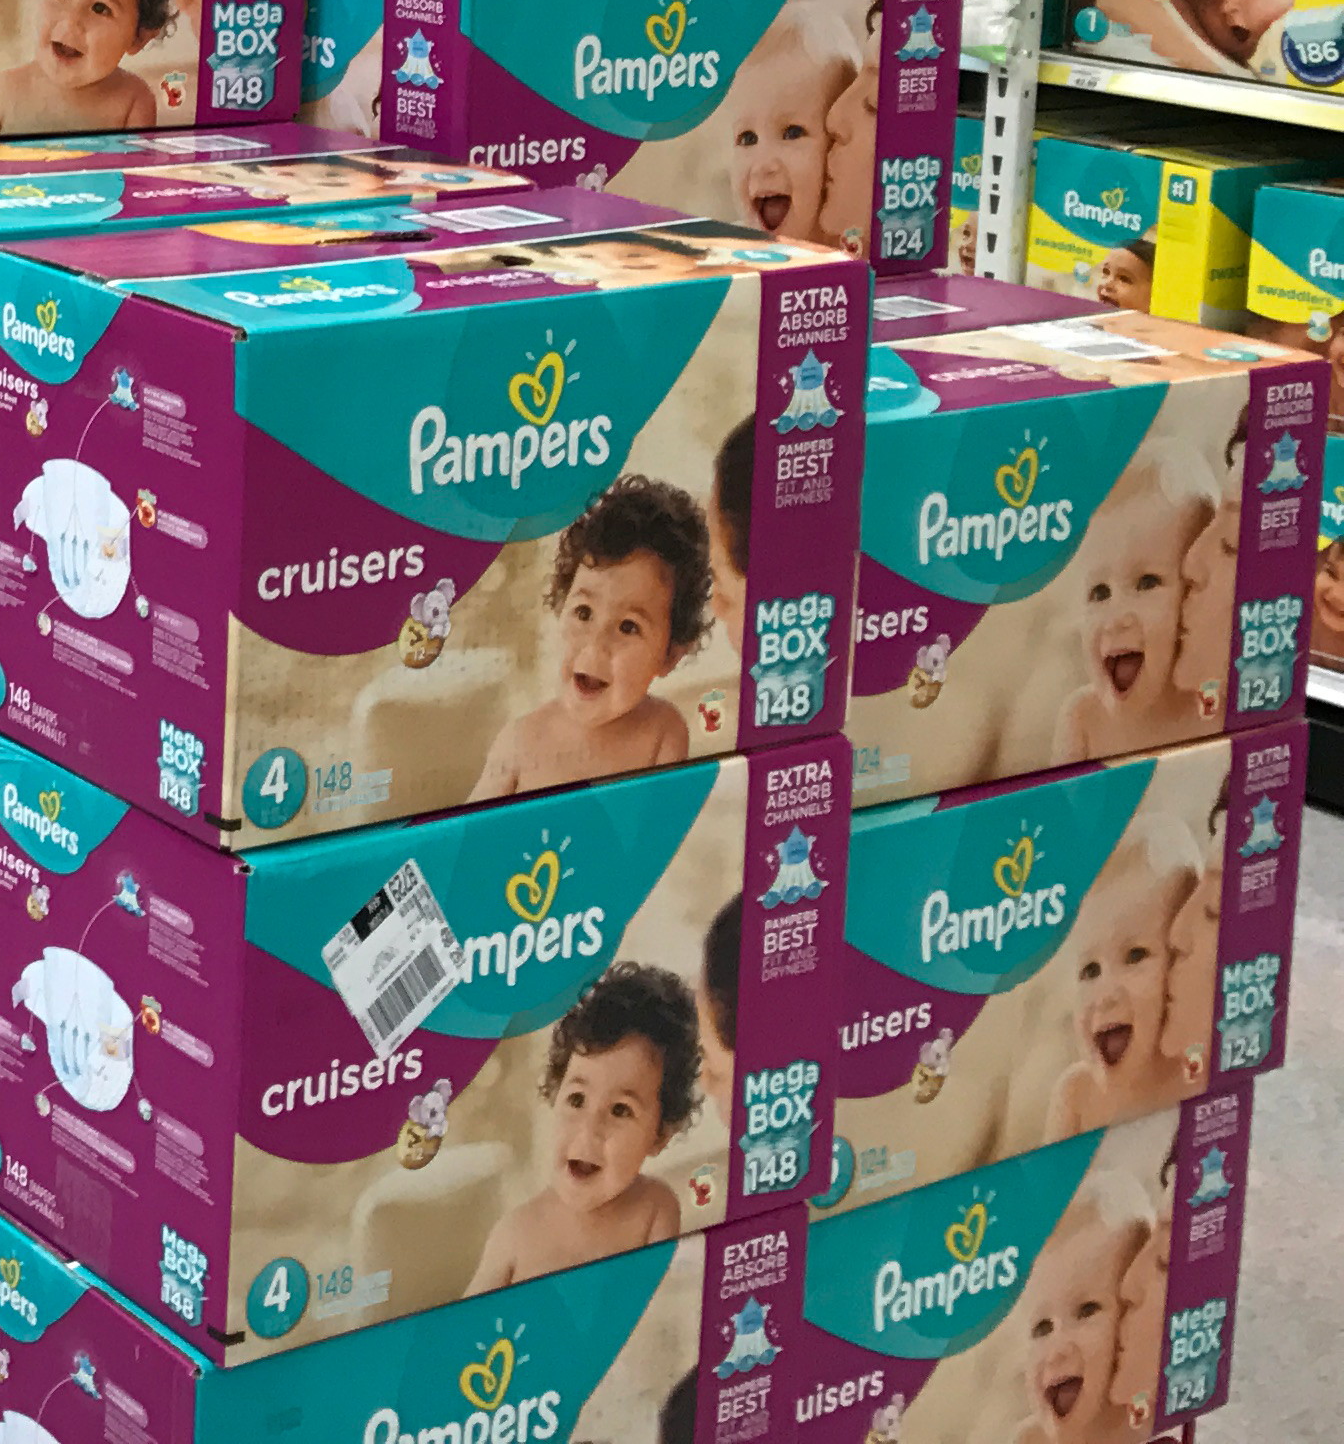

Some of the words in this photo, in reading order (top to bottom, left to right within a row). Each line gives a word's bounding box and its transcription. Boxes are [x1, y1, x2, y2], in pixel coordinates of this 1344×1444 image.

[214, 2, 283, 29] Mega
[216, 24, 277, 57] BOX
[1295, 41, 1340, 65] 186
[575, 34, 720, 104] Pampers
[216, 72, 263, 107] 148
[470, 134, 586, 169] cruisers
[1172, 179, 1193, 202] #1
[1063, 190, 1142, 232] Pampers
[1035, 238, 1094, 257] swaddlers
[780, 286, 848, 314] EXTRA
[1257, 284, 1333, 309] swaddlers
[3, 301, 76, 362] Pampers
[410, 404, 612, 496] Pampers
[918, 492, 1073, 565] Pampers
[257, 543, 426, 602] cruisers
[756, 593, 835, 635] Mega
[856, 604, 928, 643] isers
[758, 626, 828, 666] BOX
[9, 682, 31, 711] 148
[756, 684, 811, 723] 148
[2, 782, 80, 856] Pampers
[921, 881, 1067, 963] Pampers
[460, 906, 605, 986] mpers
[260, 1045, 424, 1118] cruisers
[873, 1245, 1019, 1333] Pampers
